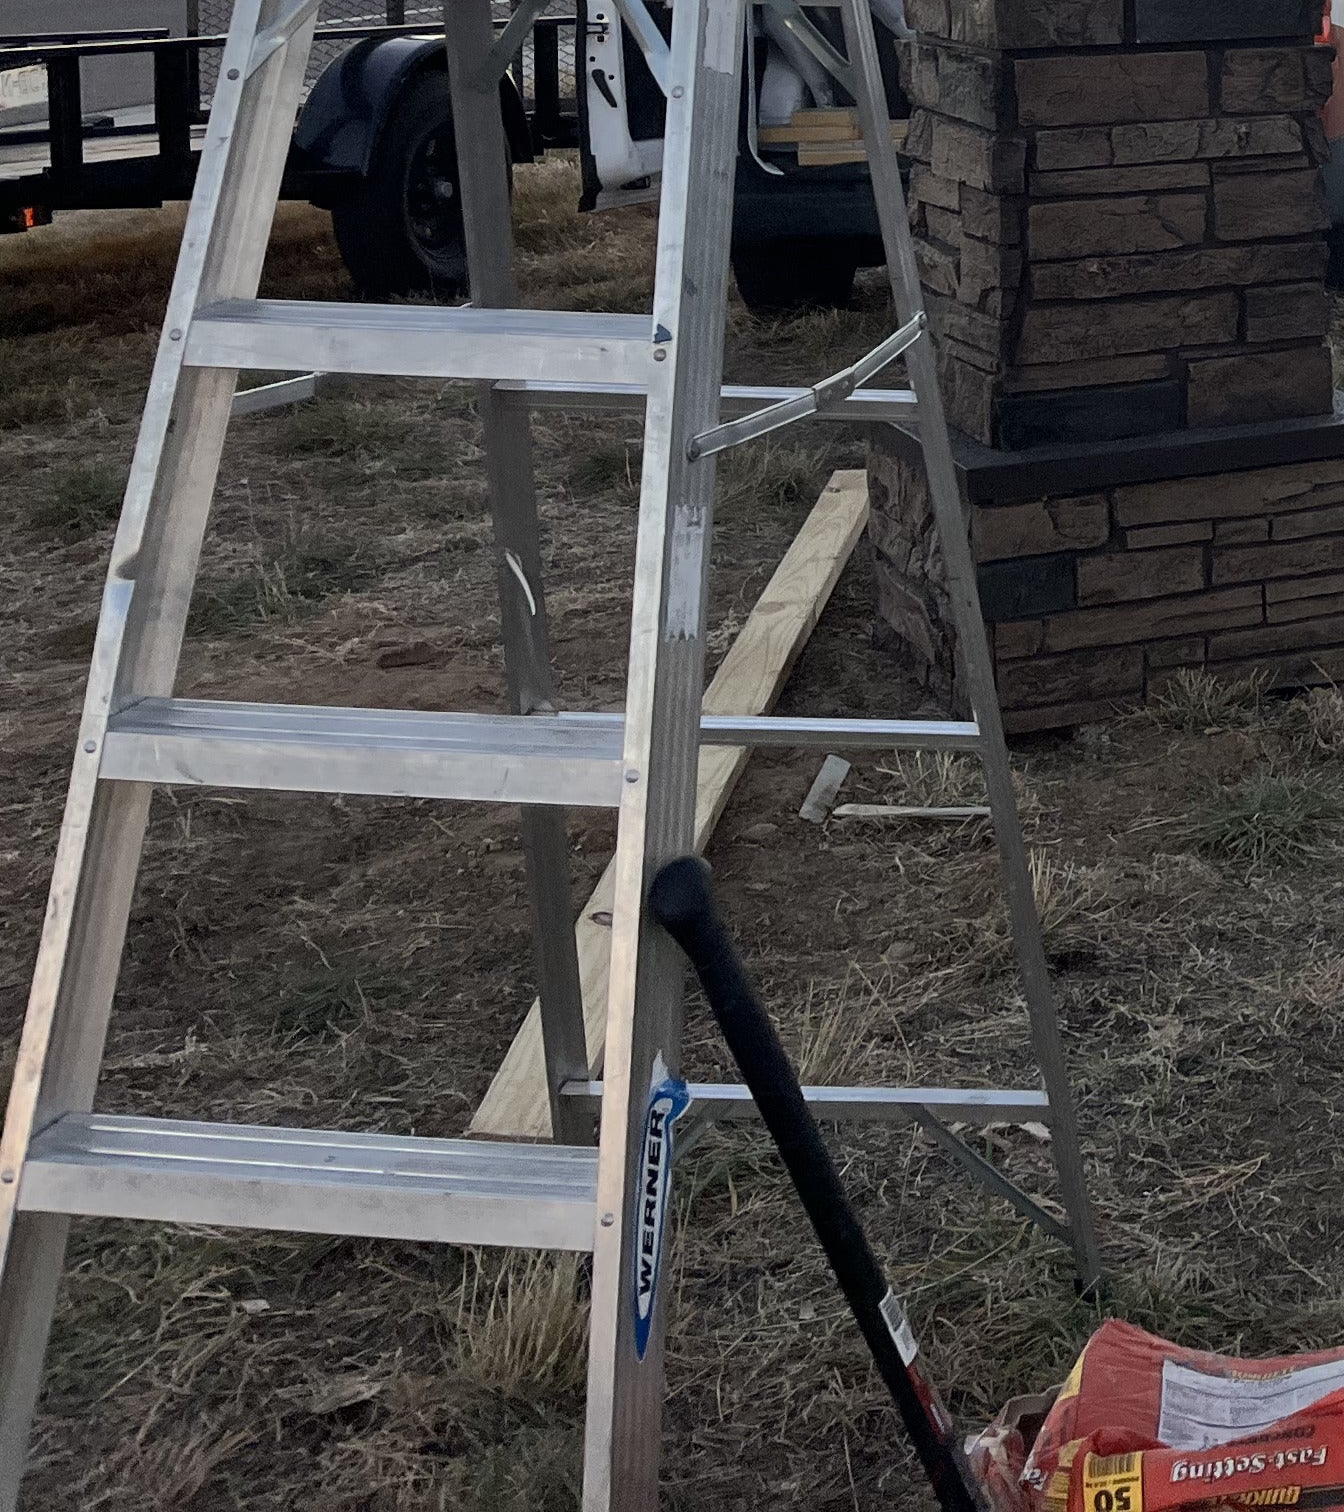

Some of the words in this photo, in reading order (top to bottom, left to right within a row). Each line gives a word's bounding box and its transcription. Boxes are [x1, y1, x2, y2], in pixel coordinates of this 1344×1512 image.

[639, 1109, 666, 1297] WERNER
[1169, 1443, 1329, 1484] Fast-Setting
[1093, 1486, 1132, 1512] 50
